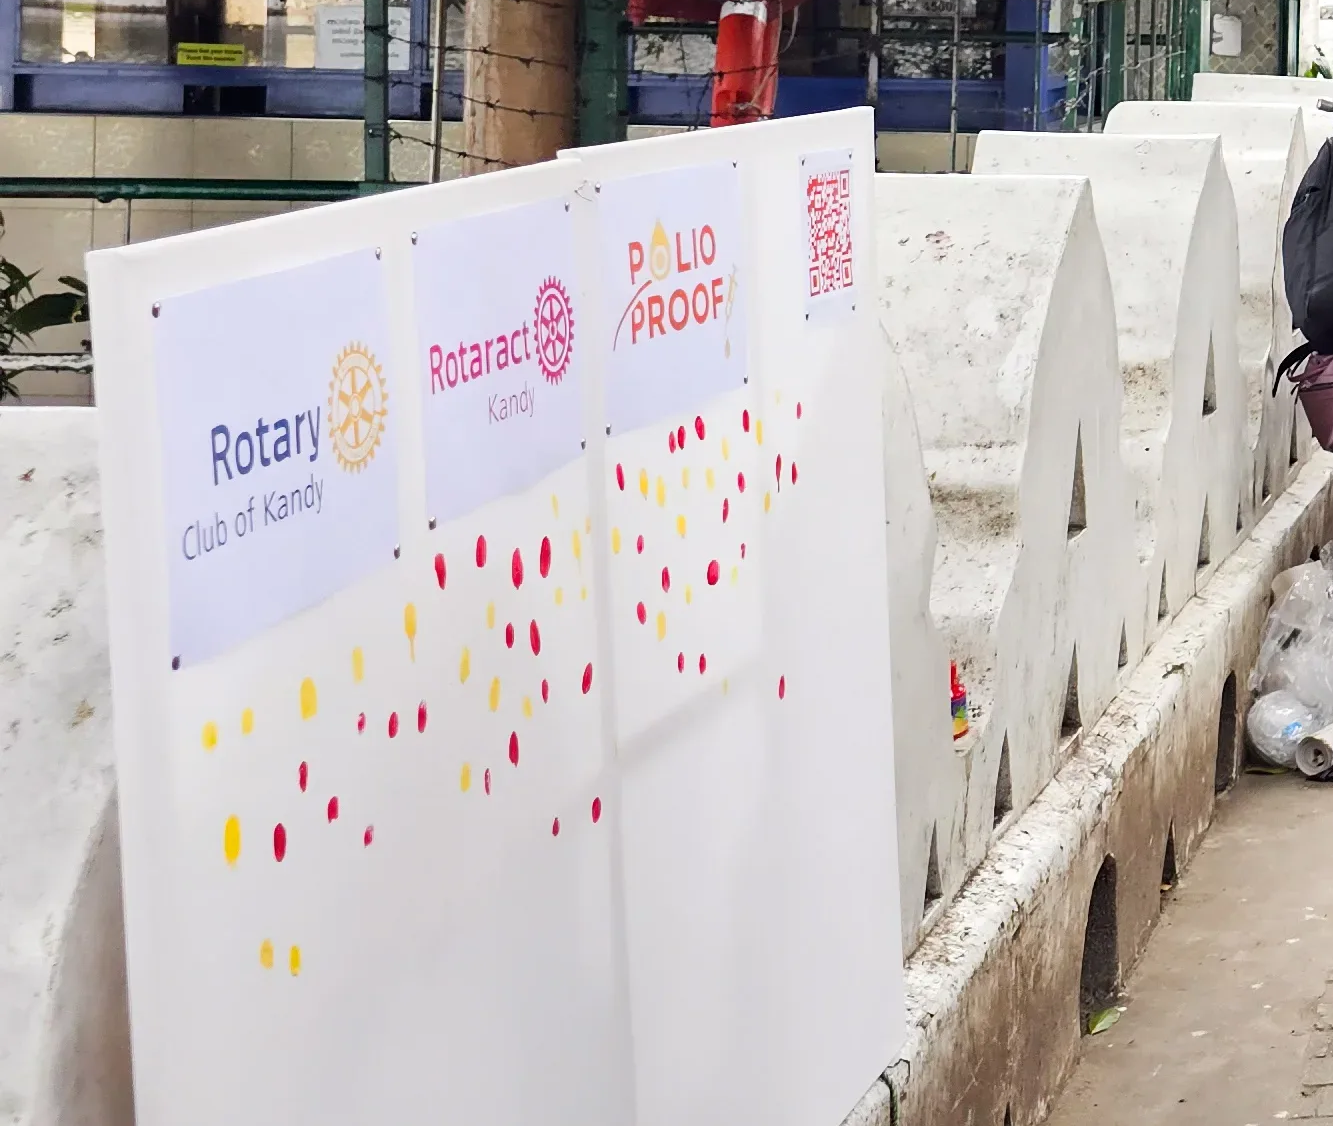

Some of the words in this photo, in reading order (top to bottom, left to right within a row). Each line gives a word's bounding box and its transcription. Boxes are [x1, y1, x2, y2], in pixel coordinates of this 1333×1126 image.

[631, 276, 724, 345] PROOF
[429, 319, 531, 395] Rotaract
[488, 380, 535, 425] Kandy
[211, 405, 321, 486] Rotary
[182, 511, 228, 561] Club
[234, 495, 255, 538] of
[263, 473, 324, 527] Kandy
